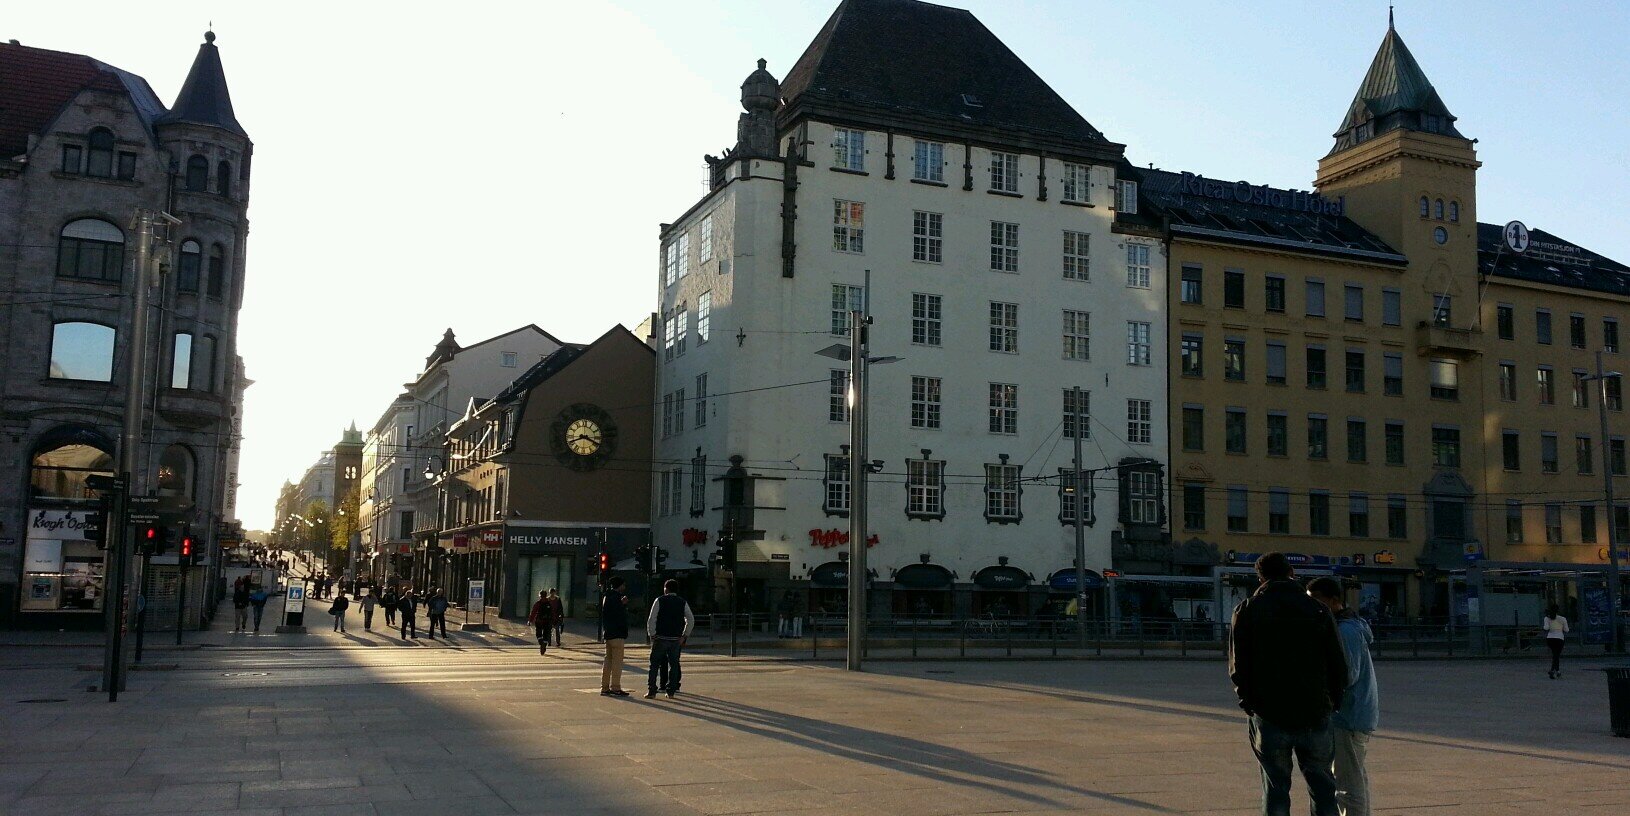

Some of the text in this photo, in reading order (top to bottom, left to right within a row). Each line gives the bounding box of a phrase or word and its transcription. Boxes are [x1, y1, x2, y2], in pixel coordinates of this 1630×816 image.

[1181, 170, 1345, 216] Rica Oslo Hotel
[483, 533, 498, 542] HH
[510, 535, 588, 546] HELLY HANSEN
